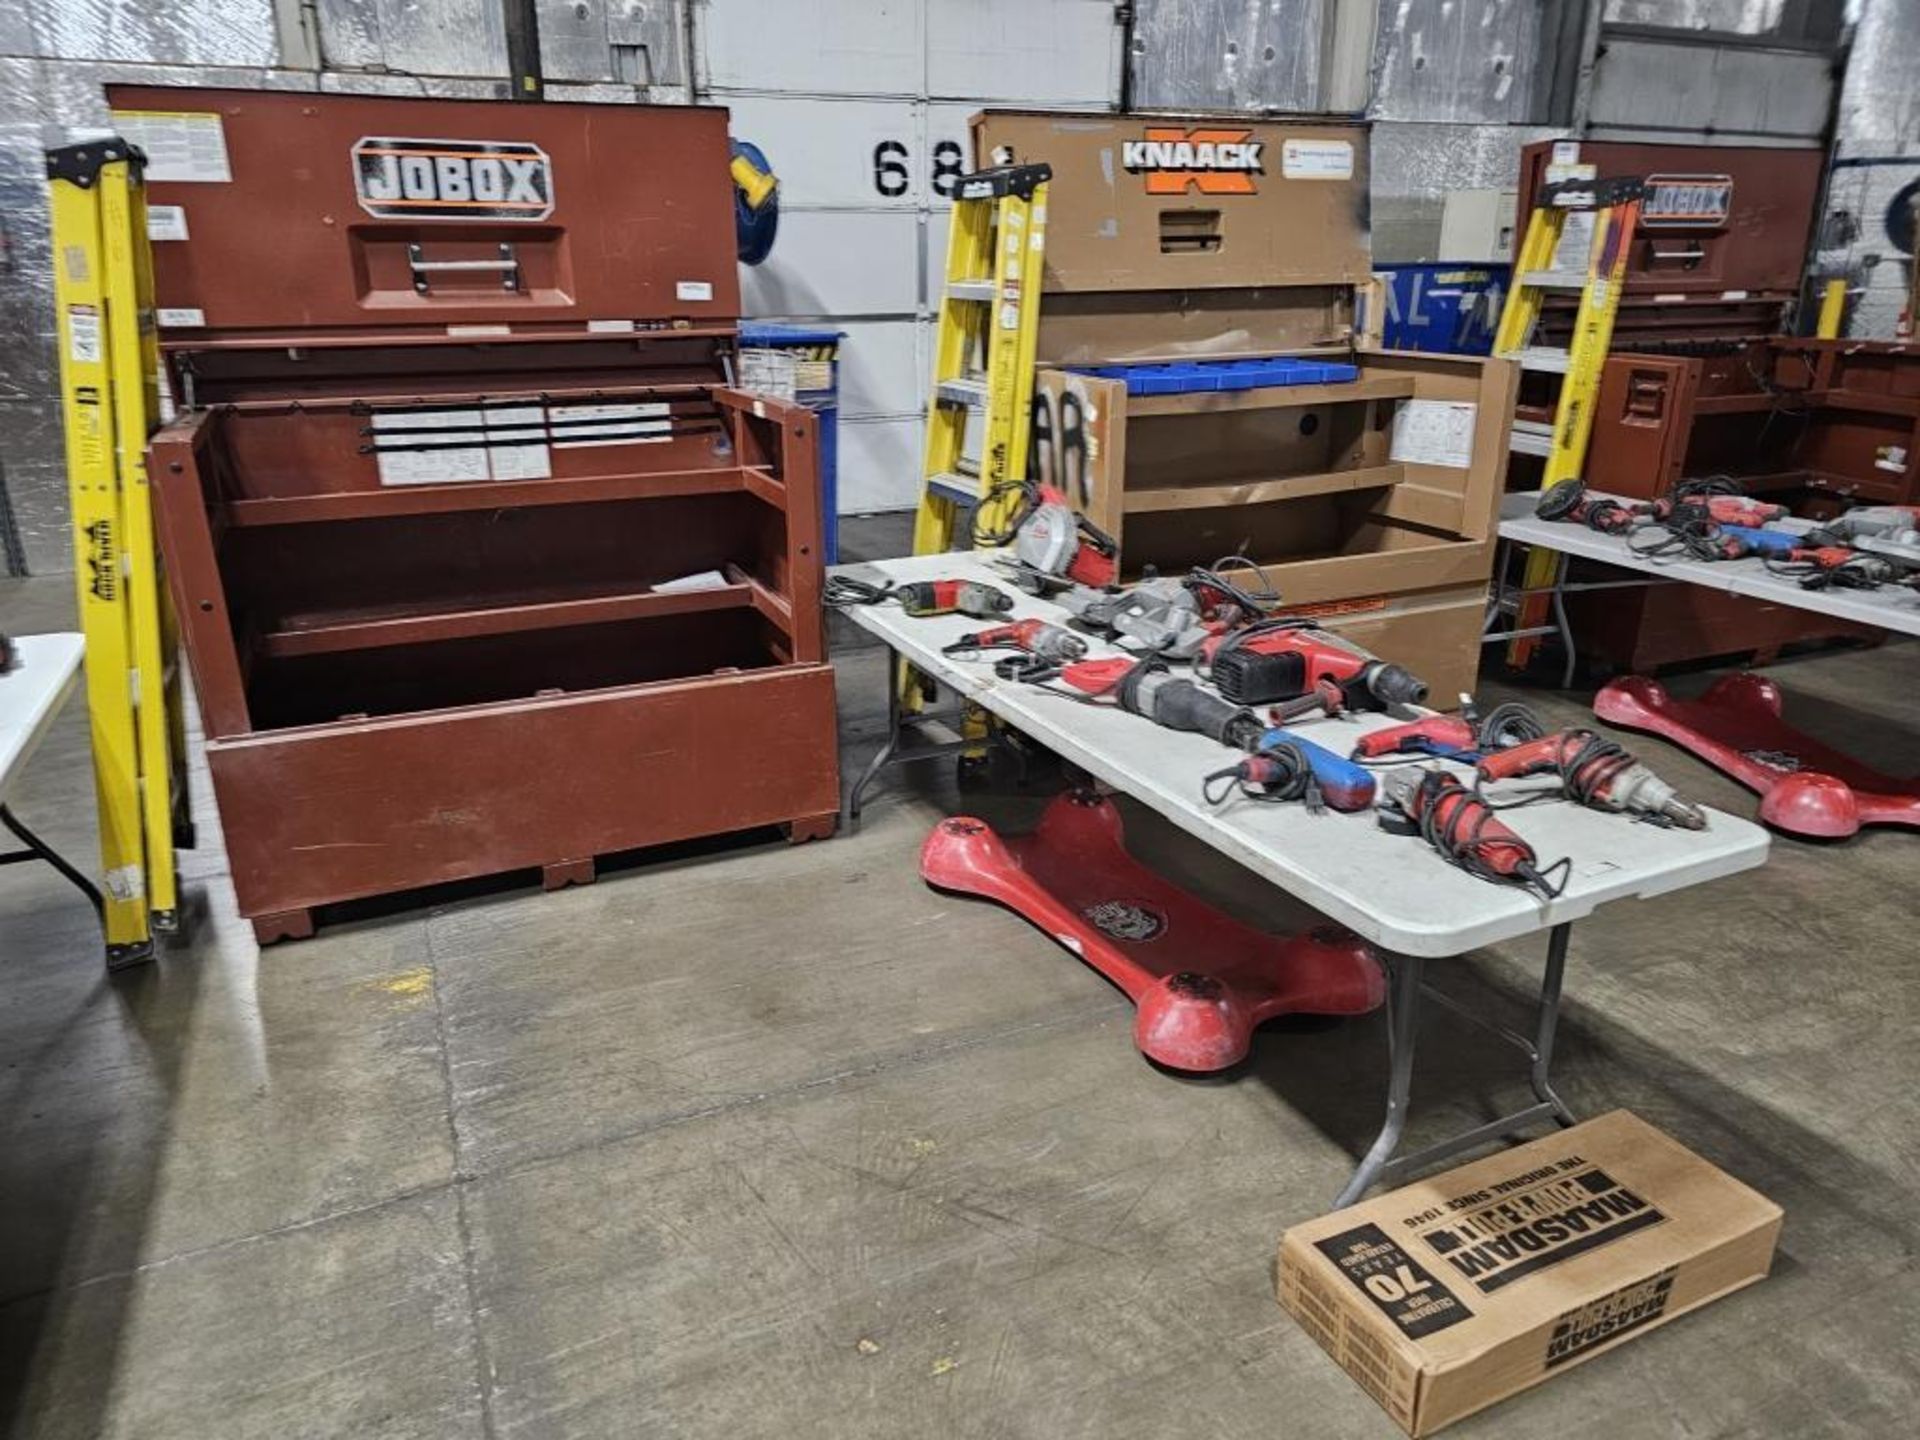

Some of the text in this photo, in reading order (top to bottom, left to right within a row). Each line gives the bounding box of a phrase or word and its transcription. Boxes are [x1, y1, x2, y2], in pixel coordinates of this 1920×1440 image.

[366, 154, 545, 203] JOBOX
[874, 140, 963, 197] 68
[1122, 140, 1264, 174] KNAACK
[1403, 1155, 1587, 1229] THE ORIGINAL SINCE 1946
[1447, 1188, 1650, 1278] MAASDAM
[1351, 1251, 1404, 1278] YEARS
[1364, 1264, 1433, 1302] 70
[1546, 1291, 1669, 1358] MAASDAM
